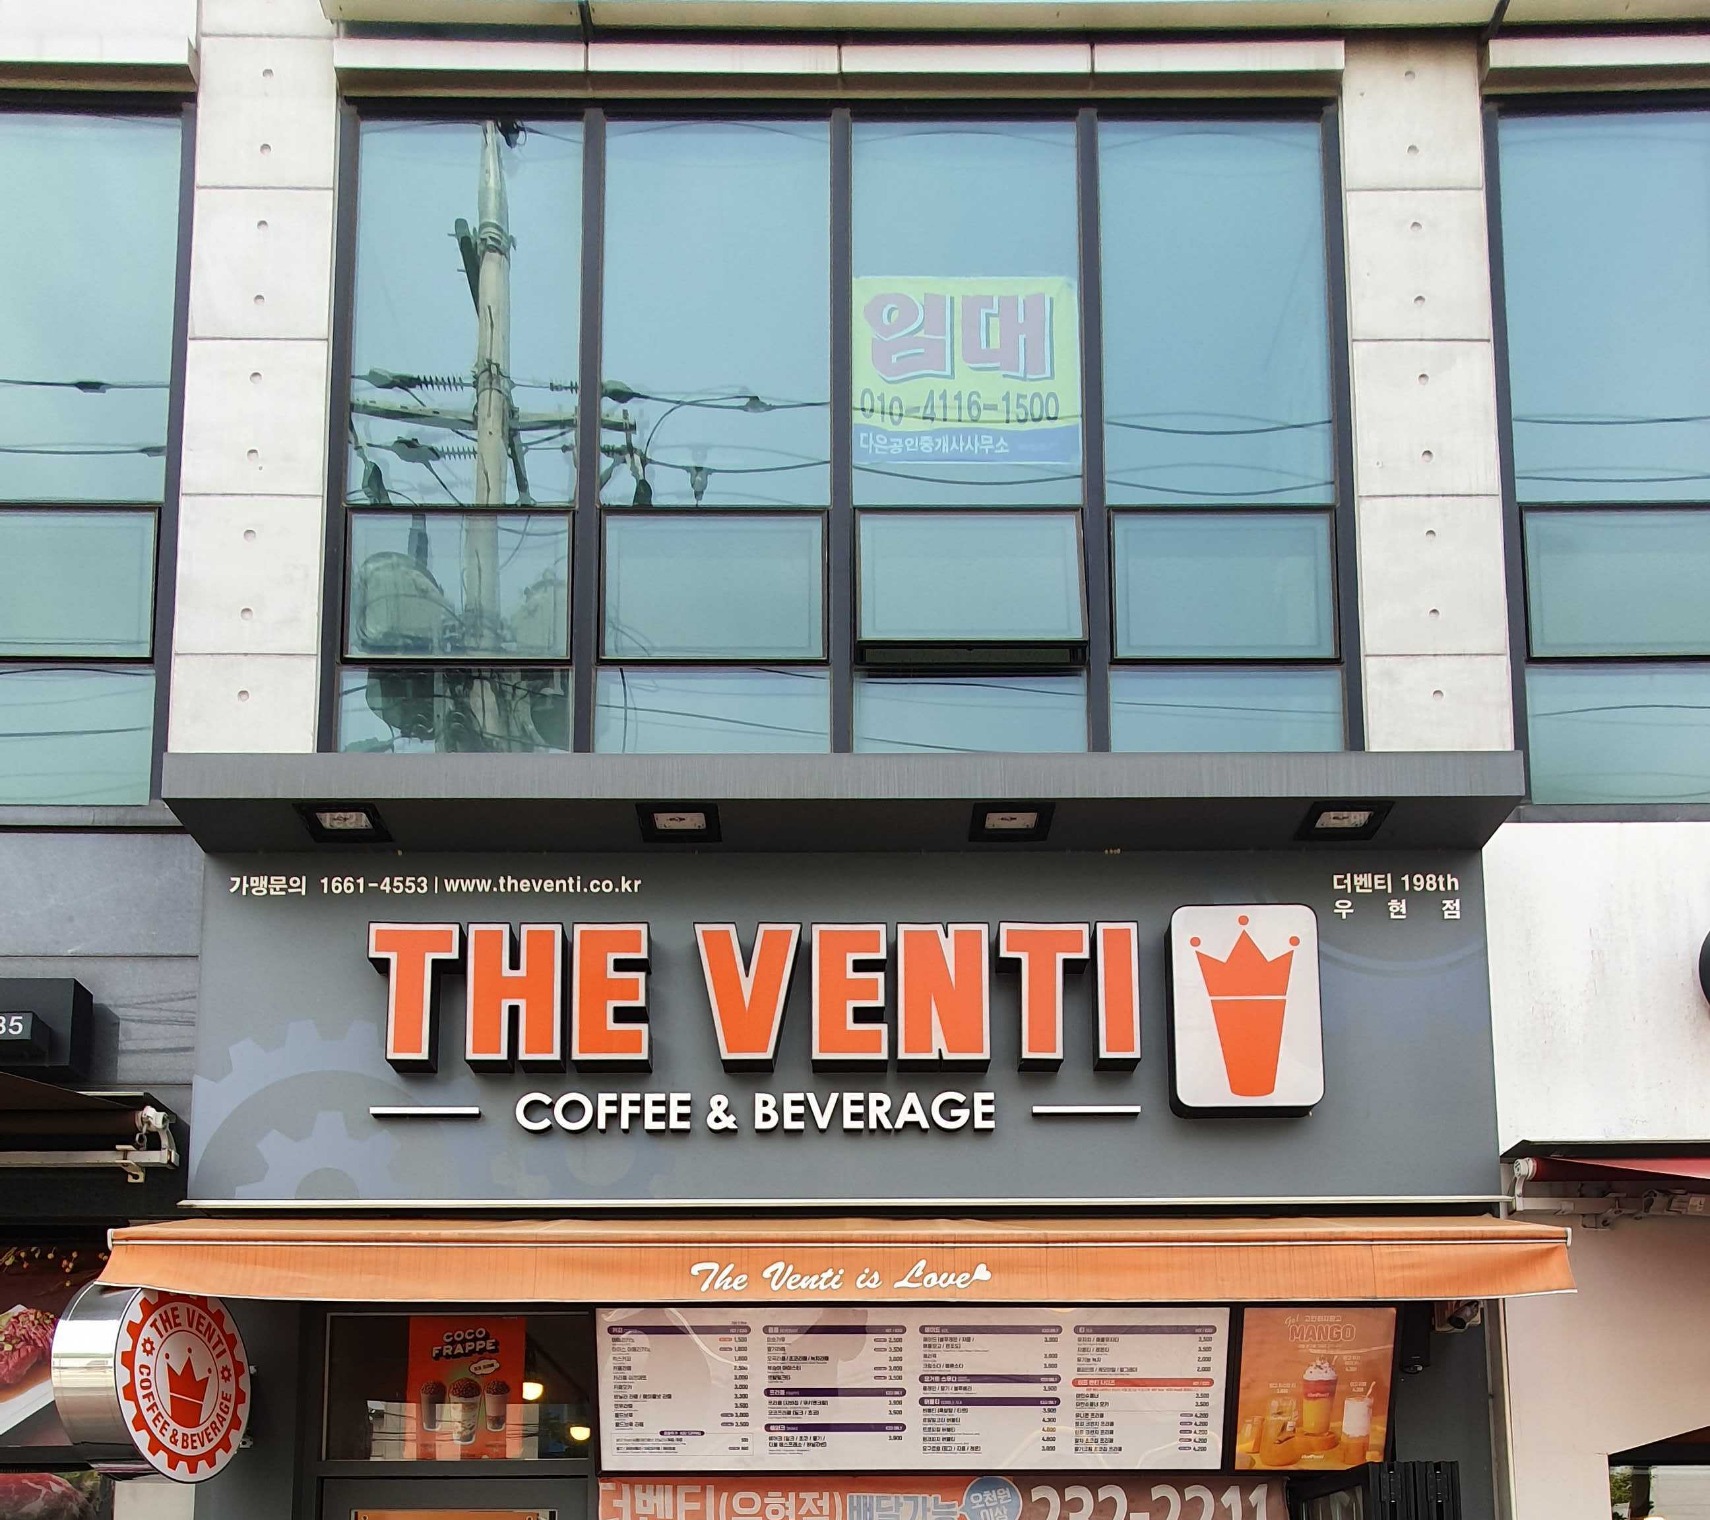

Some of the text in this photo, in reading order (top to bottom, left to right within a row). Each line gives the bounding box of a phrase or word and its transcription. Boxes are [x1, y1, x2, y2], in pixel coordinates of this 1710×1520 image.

[863, 292, 1055, 383] 임대
[860, 387, 1060, 426] 010-4116-1500
[229, 875, 642, 896] 가맹문의 1661-4553 www.theventi.co.kr
[1332, 872, 1459, 894] 더벤티 198th
[367, 921, 1143, 1074] THE VENTI
[514, 1091, 997, 1134] COFFEE & BEVERAGE
[690, 1258, 976, 1292] The Venti is Love
[150, 1306, 228, 1360] THE VENTI
[432, 1339, 498, 1358] FRAPPE
[443, 1327, 487, 1344] COCO
[1288, 1323, 1356, 1342] MANGO
[138, 1363, 232, 1450] COFFEE & BEVERAGE
[969, 1486, 1012, 1508] 오천원
